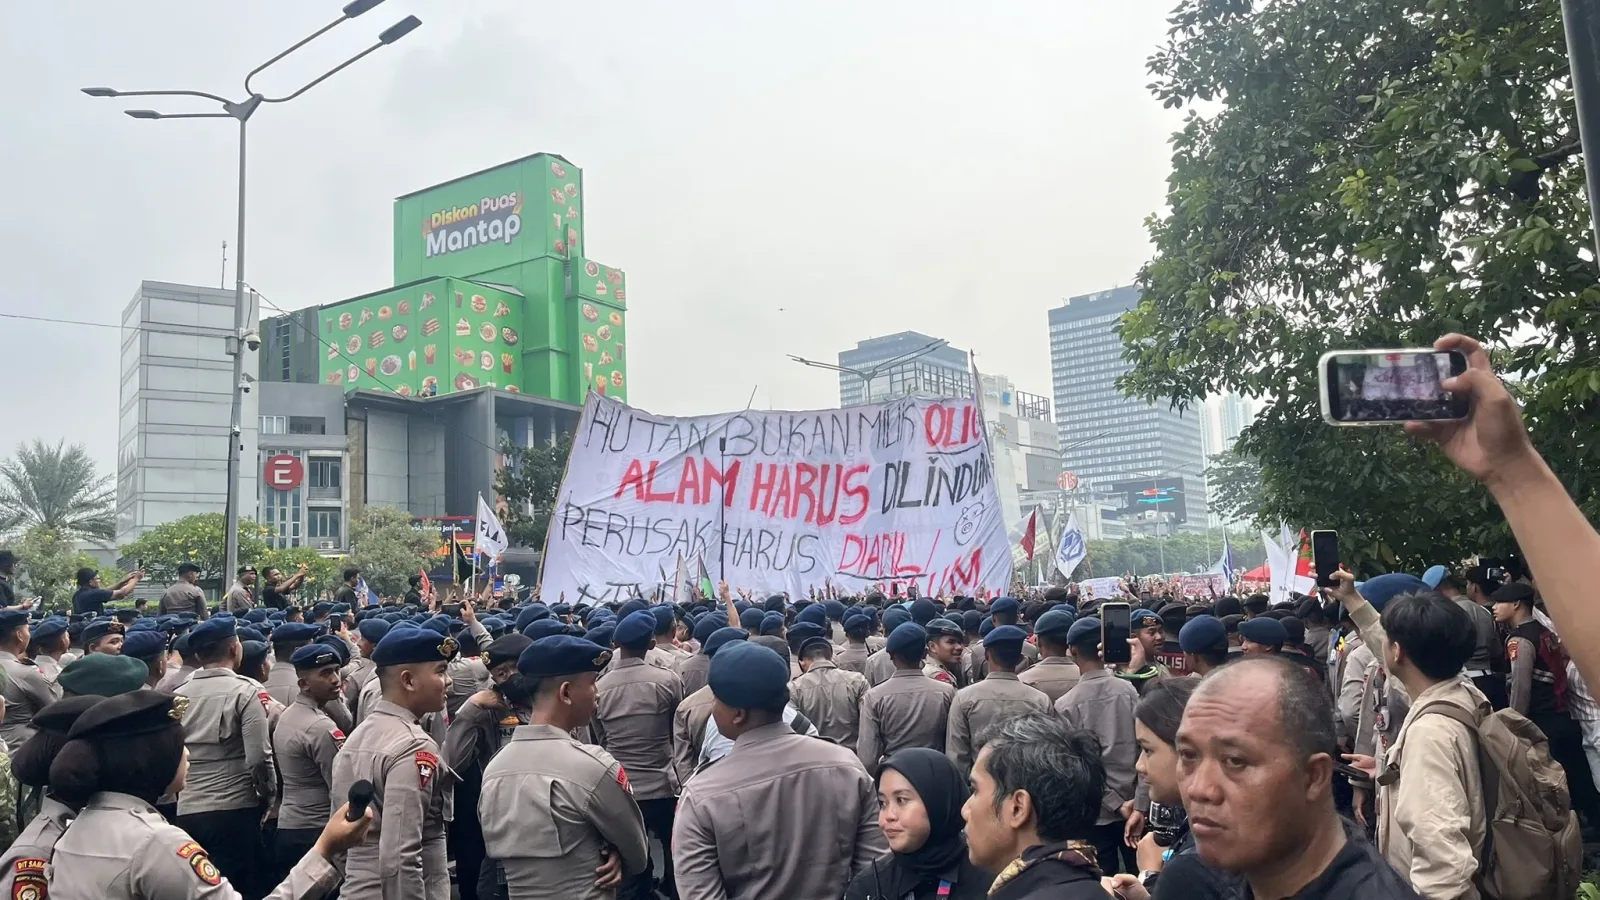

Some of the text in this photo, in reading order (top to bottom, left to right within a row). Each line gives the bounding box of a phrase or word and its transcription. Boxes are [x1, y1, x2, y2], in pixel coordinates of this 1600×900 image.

[431, 192, 517, 228] Diskon Puas
[426, 213, 521, 257] Mantap
[585, 400, 709, 455] HUTAN
[722, 414, 850, 457] BUKAN
[274, 459, 293, 484] E
[614, 456, 741, 508] ALAM
[749, 462, 870, 526] HARUS
[562, 496, 713, 558] PERUSAK
[719, 522, 819, 573] HARUS
[1154, 655, 1186, 669] OLISI
